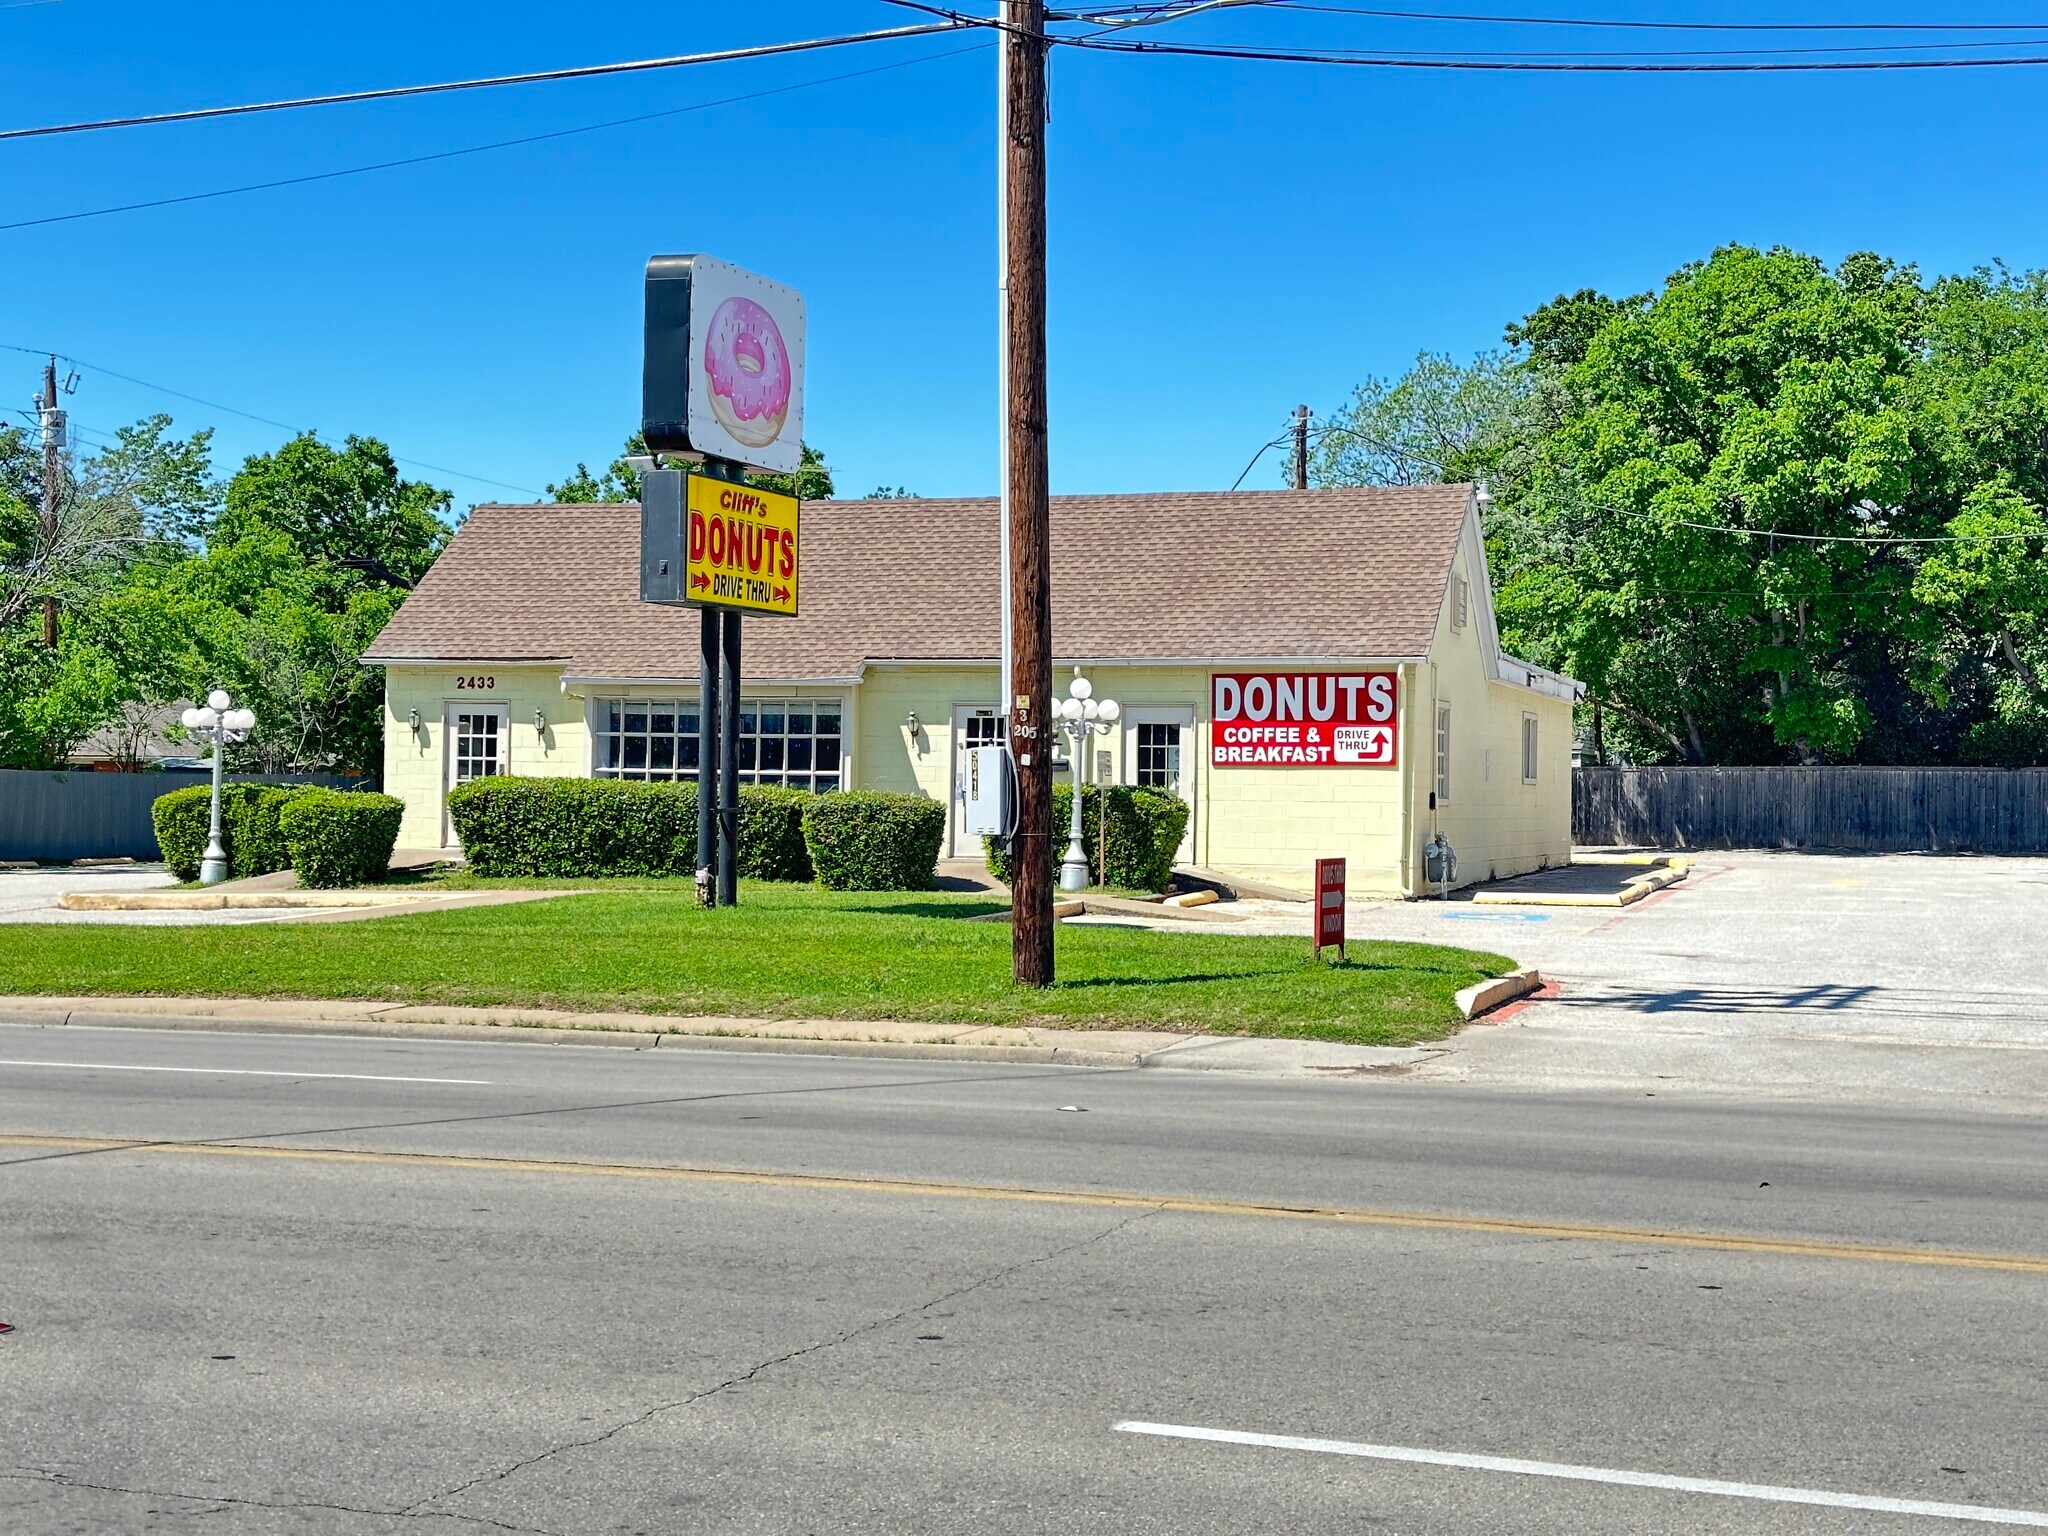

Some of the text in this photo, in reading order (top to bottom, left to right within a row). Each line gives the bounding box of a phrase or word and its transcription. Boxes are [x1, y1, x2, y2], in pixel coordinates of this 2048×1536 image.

[720, 489, 767, 518] Cliff's
[689, 509, 794, 580] DONUTS
[713, 573, 771, 603] DRIVE THRU
[457, 676, 495, 689] 2433
[1215, 676, 1393, 722] DONUTS
[1019, 710, 1028, 722] 3
[1014, 725, 1037, 739] 205
[1224, 727, 1320, 743] COFFEE &
[1337, 730, 1370, 739] DRIVE
[1338, 741, 1368, 750] THRU
[1214, 746, 1331, 762] BREAKFAST
